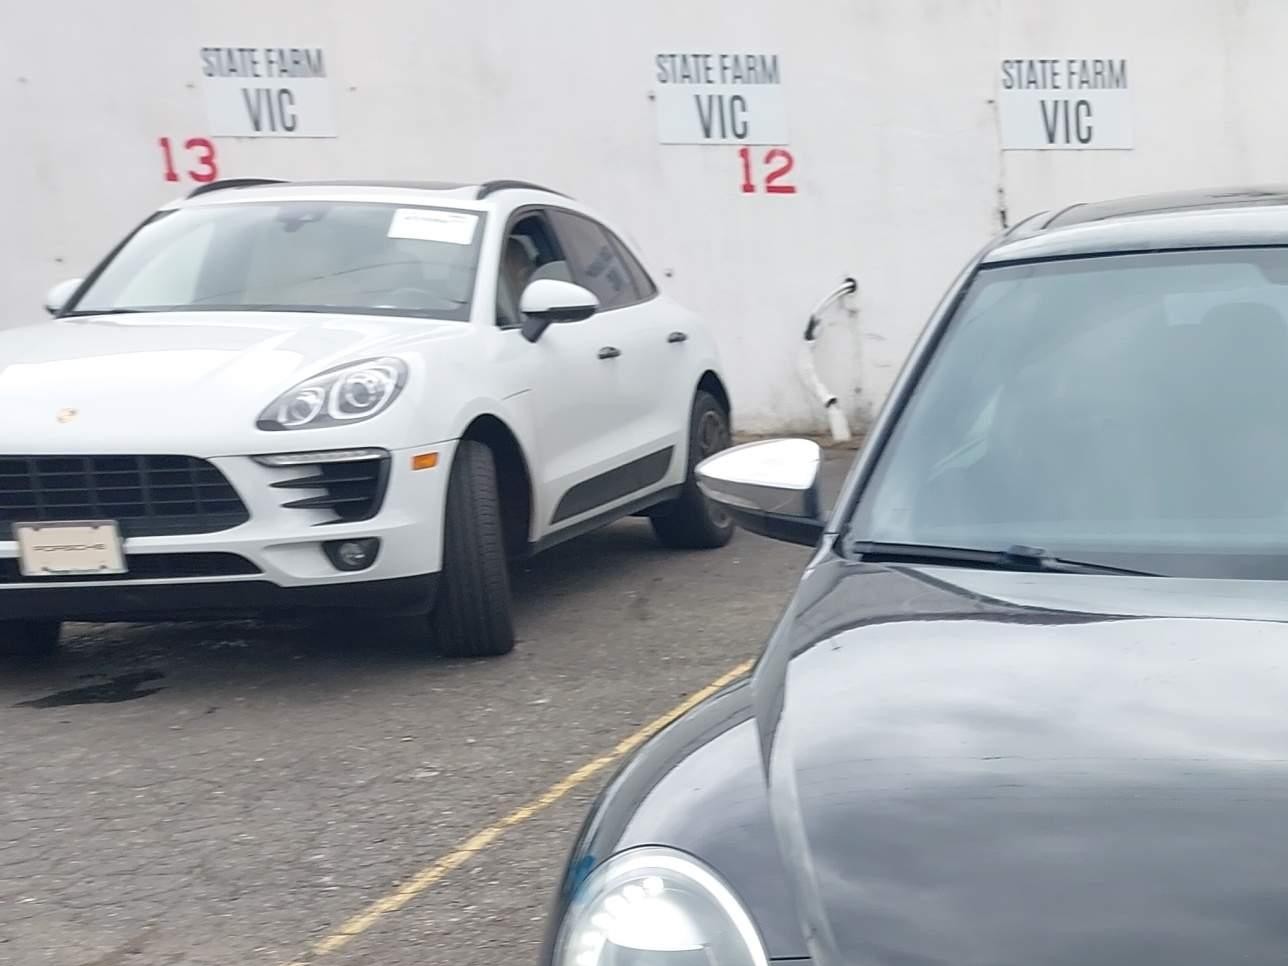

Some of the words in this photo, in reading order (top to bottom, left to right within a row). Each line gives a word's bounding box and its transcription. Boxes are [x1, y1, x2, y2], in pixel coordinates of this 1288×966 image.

[200, 47, 261, 78] STATE
[264, 48, 327, 78] FARM
[656, 54, 715, 84] STATE
[718, 54, 781, 84] FARM
[1001, 59, 1061, 90] STATE
[1066, 59, 1128, 90] FARM
[241, 87, 297, 132] VIC
[694, 94, 749, 139] VIC
[1039, 99, 1093, 144] VIC
[159, 137, 218, 182] 13
[739, 148, 796, 193] 12
